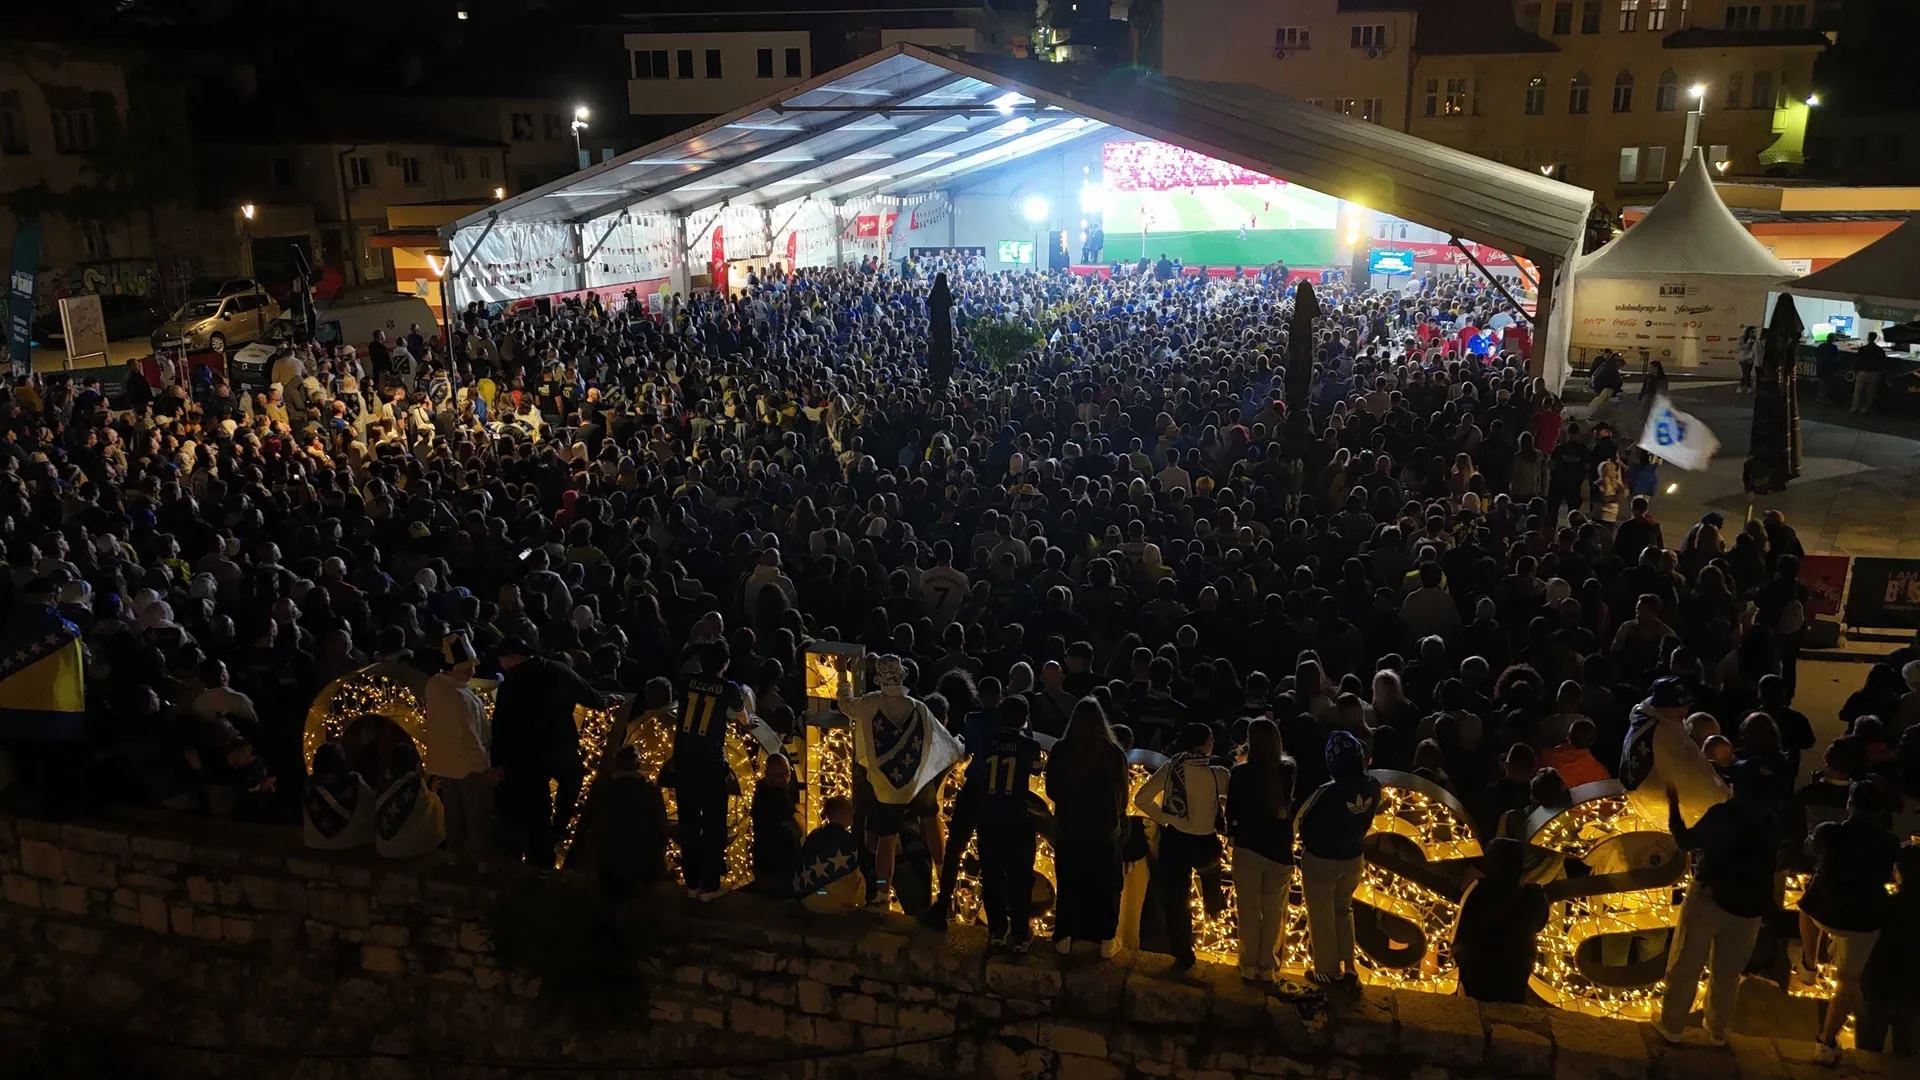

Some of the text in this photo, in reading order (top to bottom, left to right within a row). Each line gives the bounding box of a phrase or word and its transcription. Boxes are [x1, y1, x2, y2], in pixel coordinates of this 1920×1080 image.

[933, 586, 950, 611] 7
[682, 691, 717, 736] 11
[985, 755, 1017, 796] 11
